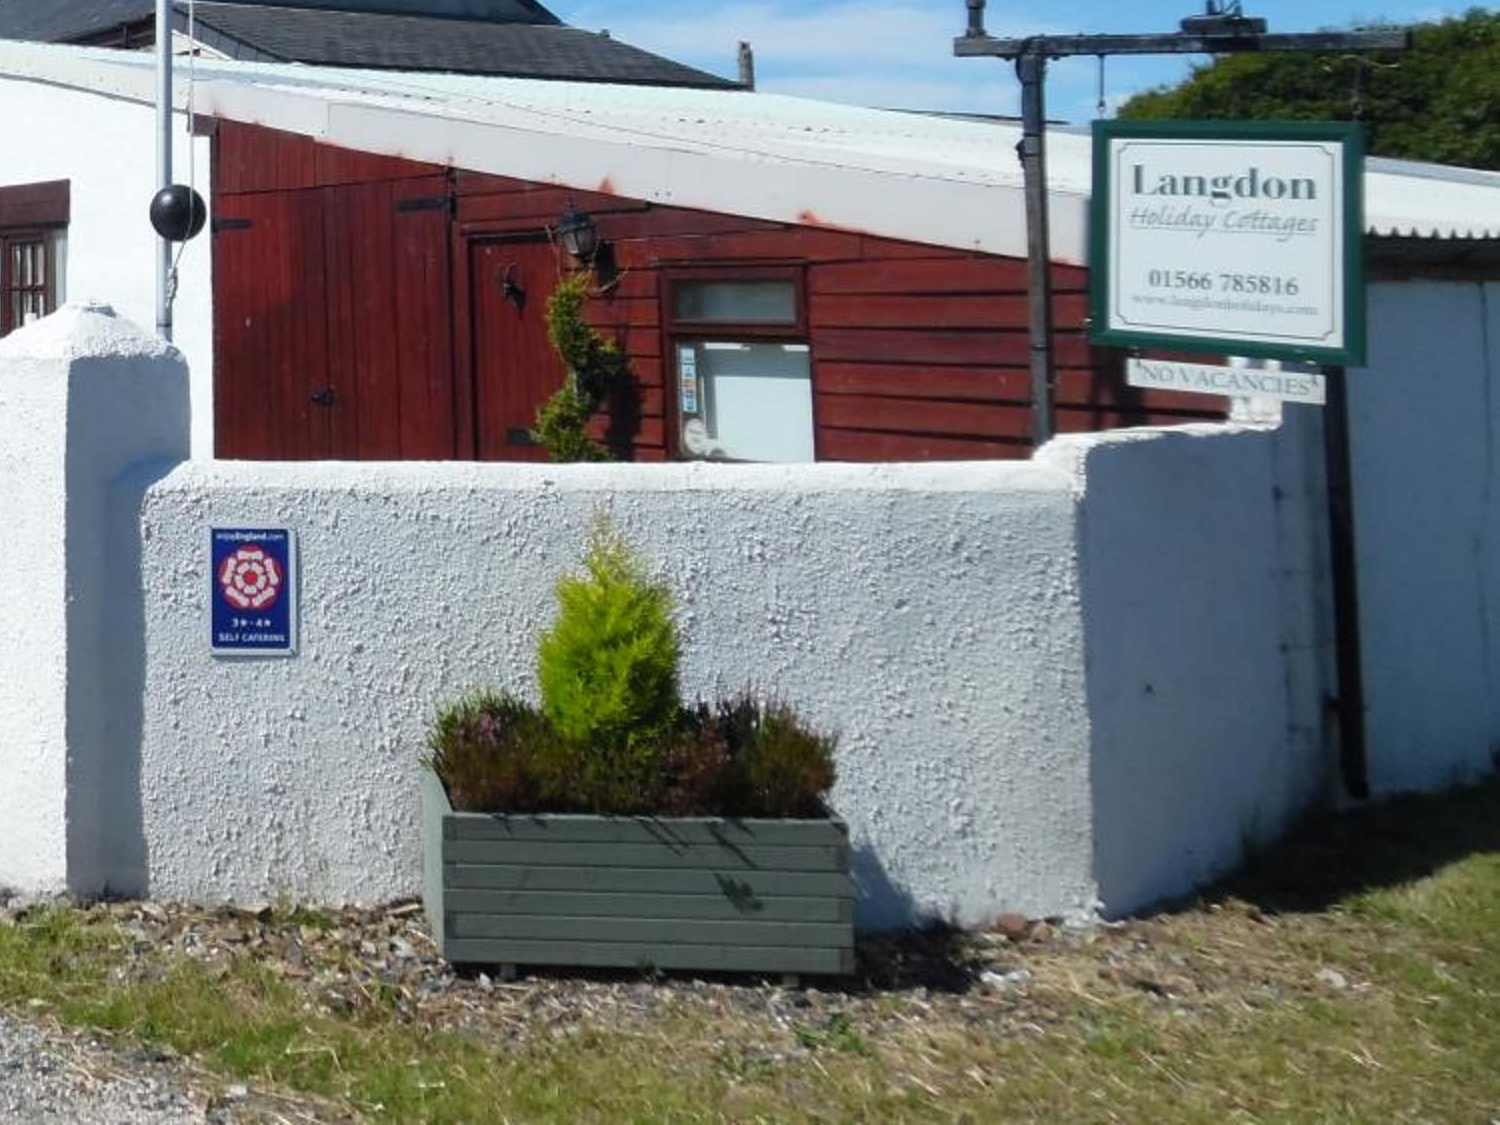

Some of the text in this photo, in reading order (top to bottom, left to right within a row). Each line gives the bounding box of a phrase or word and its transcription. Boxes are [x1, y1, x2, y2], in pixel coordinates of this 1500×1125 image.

[1132, 164, 1317, 208] Langdon
[1128, 205, 1319, 242] Holiday Cottages
[1148, 269, 1300, 296] 01566 785816
[1142, 364, 1310, 396] NO VACANCIES
[218, 632, 285, 642] SELF CATERING
